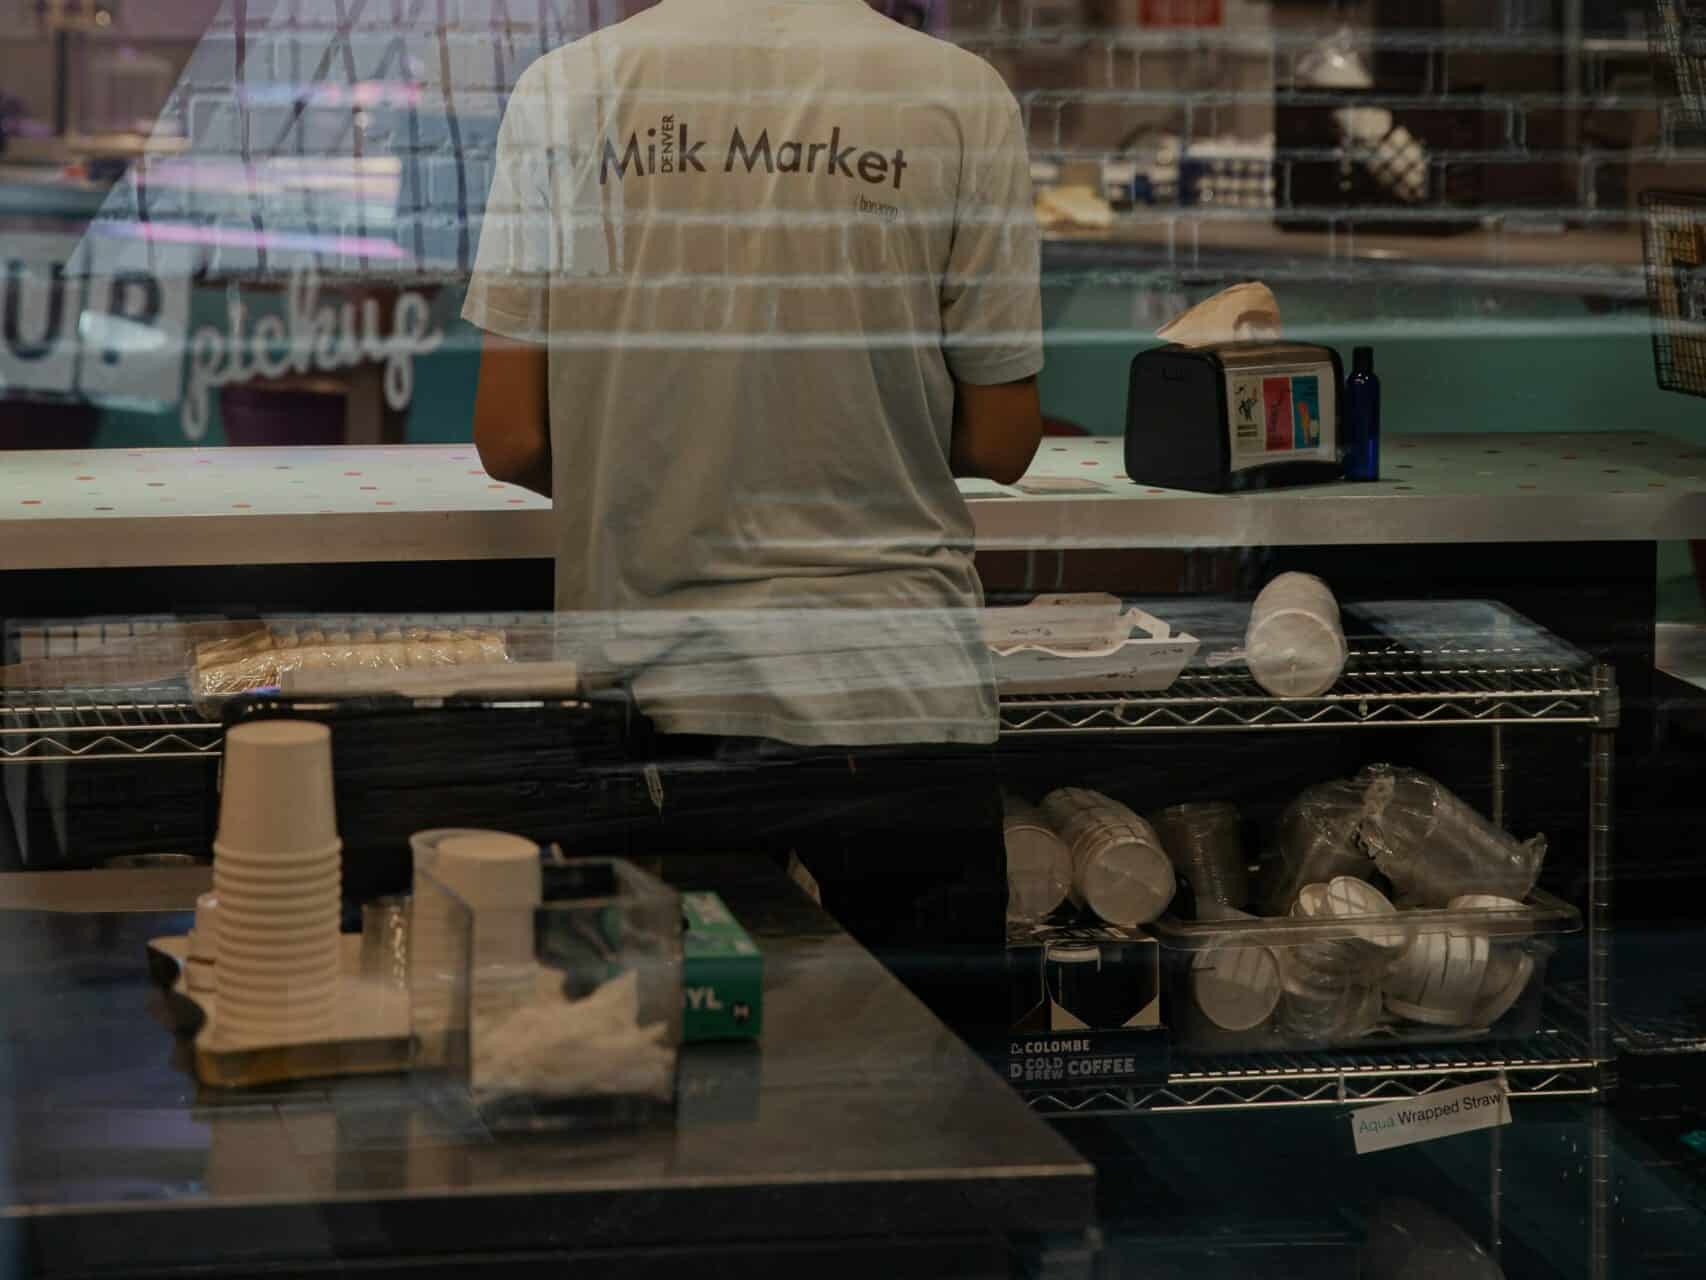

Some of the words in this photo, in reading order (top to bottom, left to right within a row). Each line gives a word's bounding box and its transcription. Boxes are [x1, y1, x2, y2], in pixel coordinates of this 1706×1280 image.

[661, 113, 675, 174] DENVER
[725, 126, 907, 190] Market
[1025, 1039, 1091, 1054] COLOMBE
[1025, 1057, 1064, 1070] COLD
[1068, 1057, 1135, 1076] COFFEE
[1359, 1116, 1396, 1134] Aqua
[1398, 1100, 1460, 1127] Wrapped
